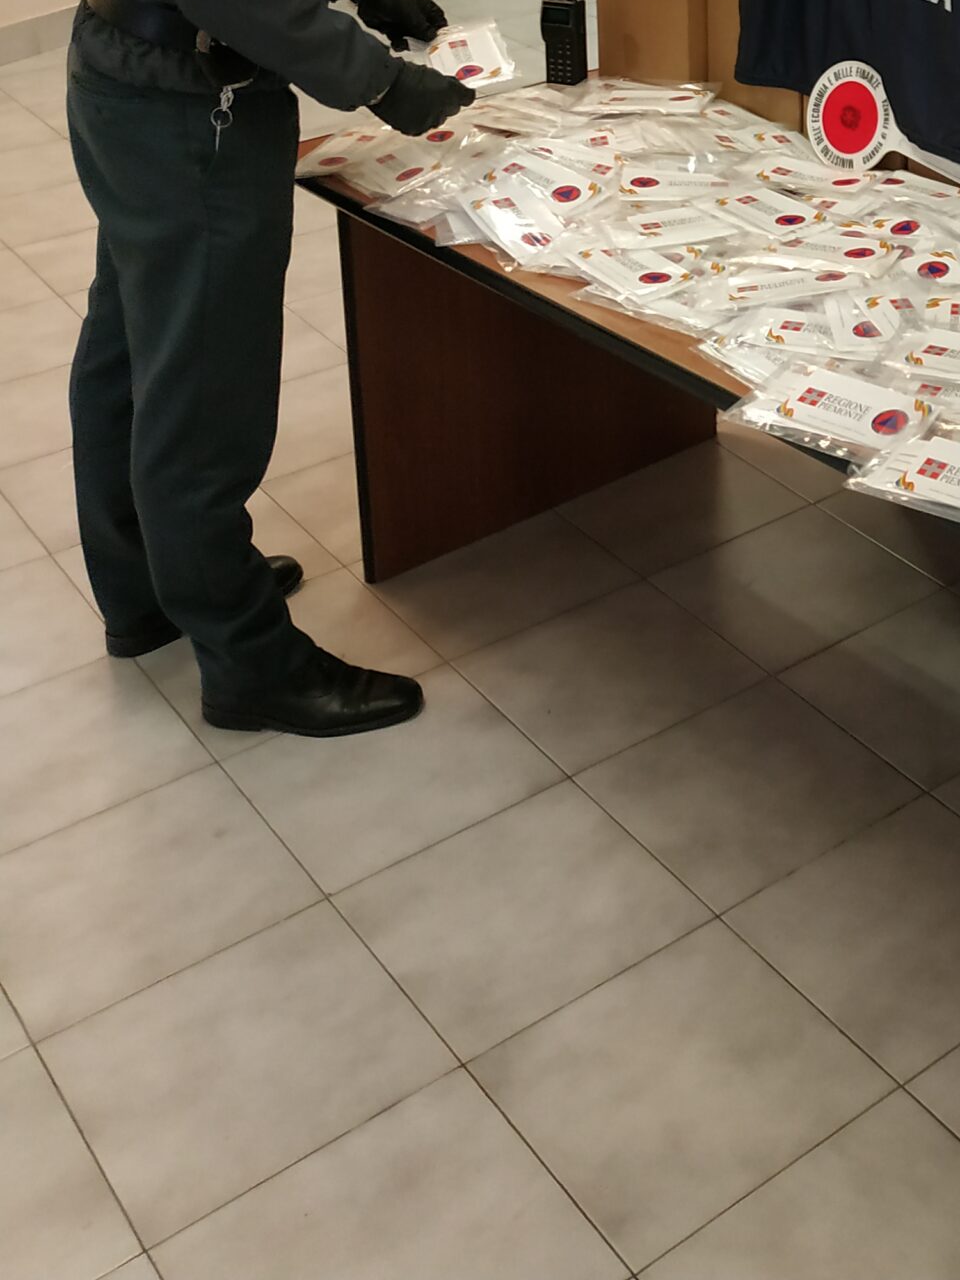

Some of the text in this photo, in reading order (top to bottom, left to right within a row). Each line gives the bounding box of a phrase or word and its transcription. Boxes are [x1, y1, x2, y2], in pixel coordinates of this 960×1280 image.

[833, 66, 853, 81] DELLE
[855, 66, 881, 90] FINANZE
[811, 83, 829, 123] ECONOMIA
[820, 145, 854, 169] MINISTERO
[818, 402, 864, 422] PIEMONTE
[824, 393, 872, 415] REGIONE
